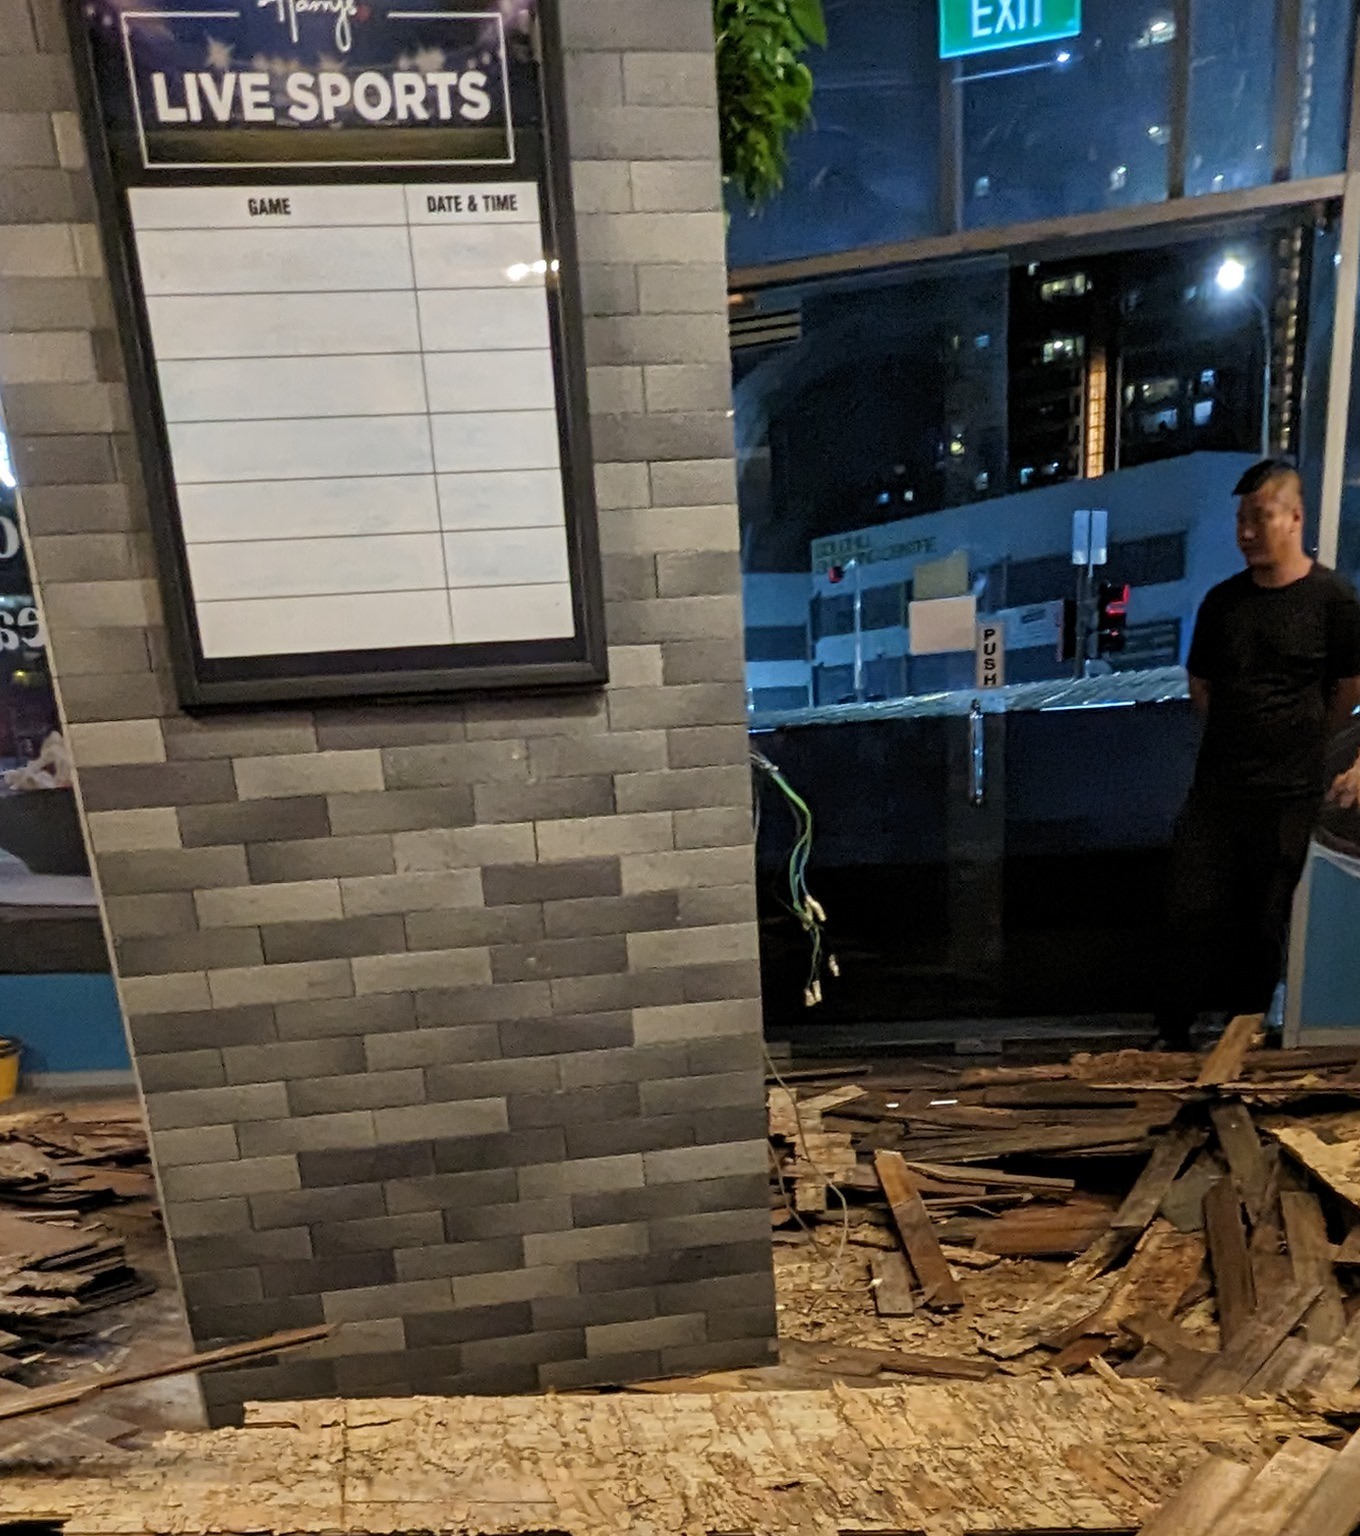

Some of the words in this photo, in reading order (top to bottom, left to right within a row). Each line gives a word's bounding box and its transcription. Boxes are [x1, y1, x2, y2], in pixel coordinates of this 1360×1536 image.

[152, 71, 276, 123] LIVE
[286, 70, 491, 122] SPORTS
[248, 197, 291, 216] GAME
[427, 195, 462, 213] DATE
[468, 196, 479, 213] &
[482, 194, 519, 213] TIME
[983, 628, 997, 686] PUSH
